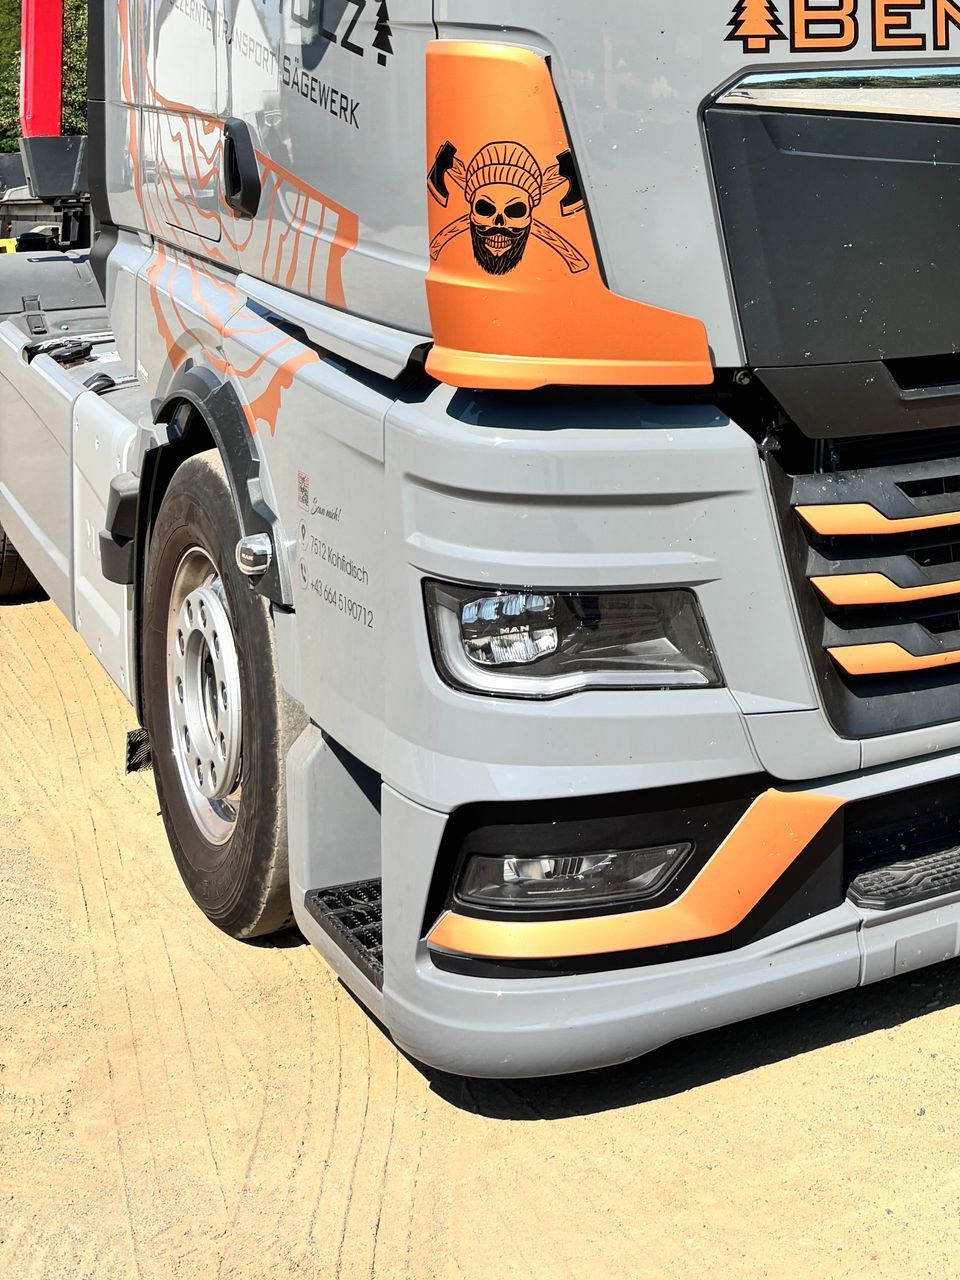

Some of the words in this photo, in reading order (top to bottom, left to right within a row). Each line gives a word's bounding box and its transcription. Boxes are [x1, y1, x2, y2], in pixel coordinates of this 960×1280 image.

[310, 535, 327, 561] 7512
[327, 545, 369, 586] Kohfidisch
[310, 579, 323, 598] +43
[323, 584, 337, 607] 664
[338, 593, 374, 629] 5190712
[499, 624, 530, 635] MAN
